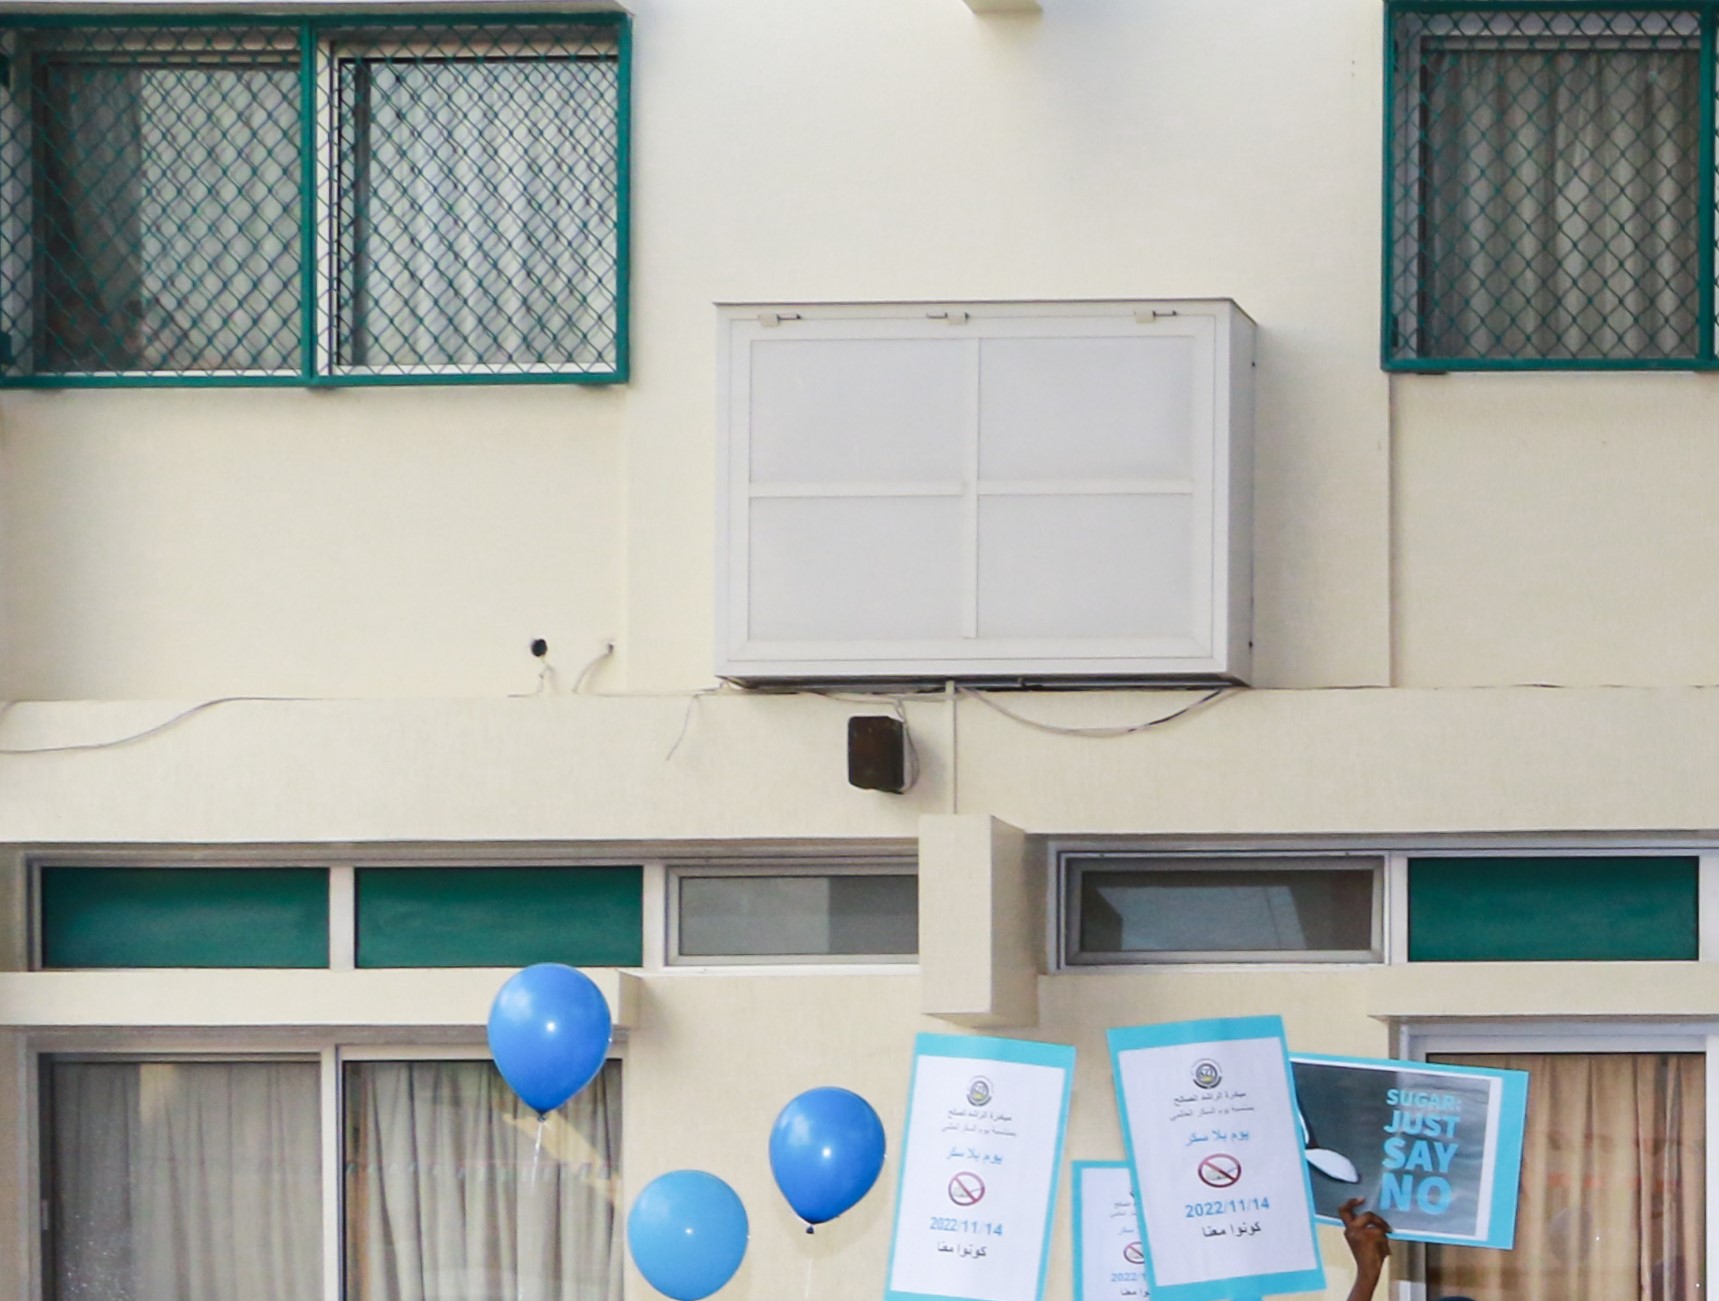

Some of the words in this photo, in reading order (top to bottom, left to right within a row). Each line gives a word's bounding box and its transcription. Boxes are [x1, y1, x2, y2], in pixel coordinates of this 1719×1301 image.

[1383, 1109, 1461, 1139] JUST
[1382, 1136, 1459, 1173] SAY
[1185, 1197, 1270, 1218] 2022/11/14
[1379, 1171, 1453, 1216] NO
[929, 1216, 1004, 1237] 2022/11/14
